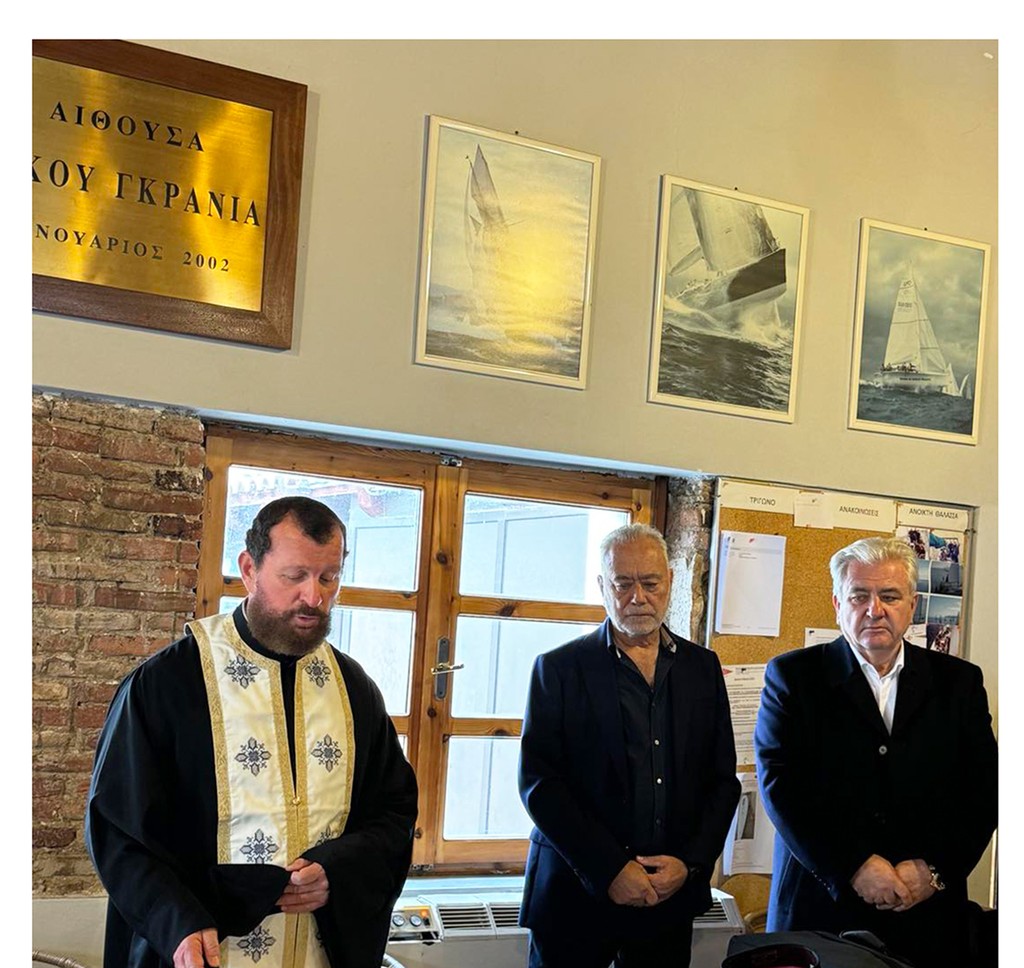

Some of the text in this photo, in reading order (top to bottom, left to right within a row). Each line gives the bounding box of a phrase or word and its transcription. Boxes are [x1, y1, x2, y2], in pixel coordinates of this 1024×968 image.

[50, 101, 205, 152] ΑΙΘΟΥΣΑ
[115, 172, 261, 227] ΓΚΡΑΝΙΑ
[36, 223, 230, 273] ΝΟΥΑΡΙΟΣ 2002
